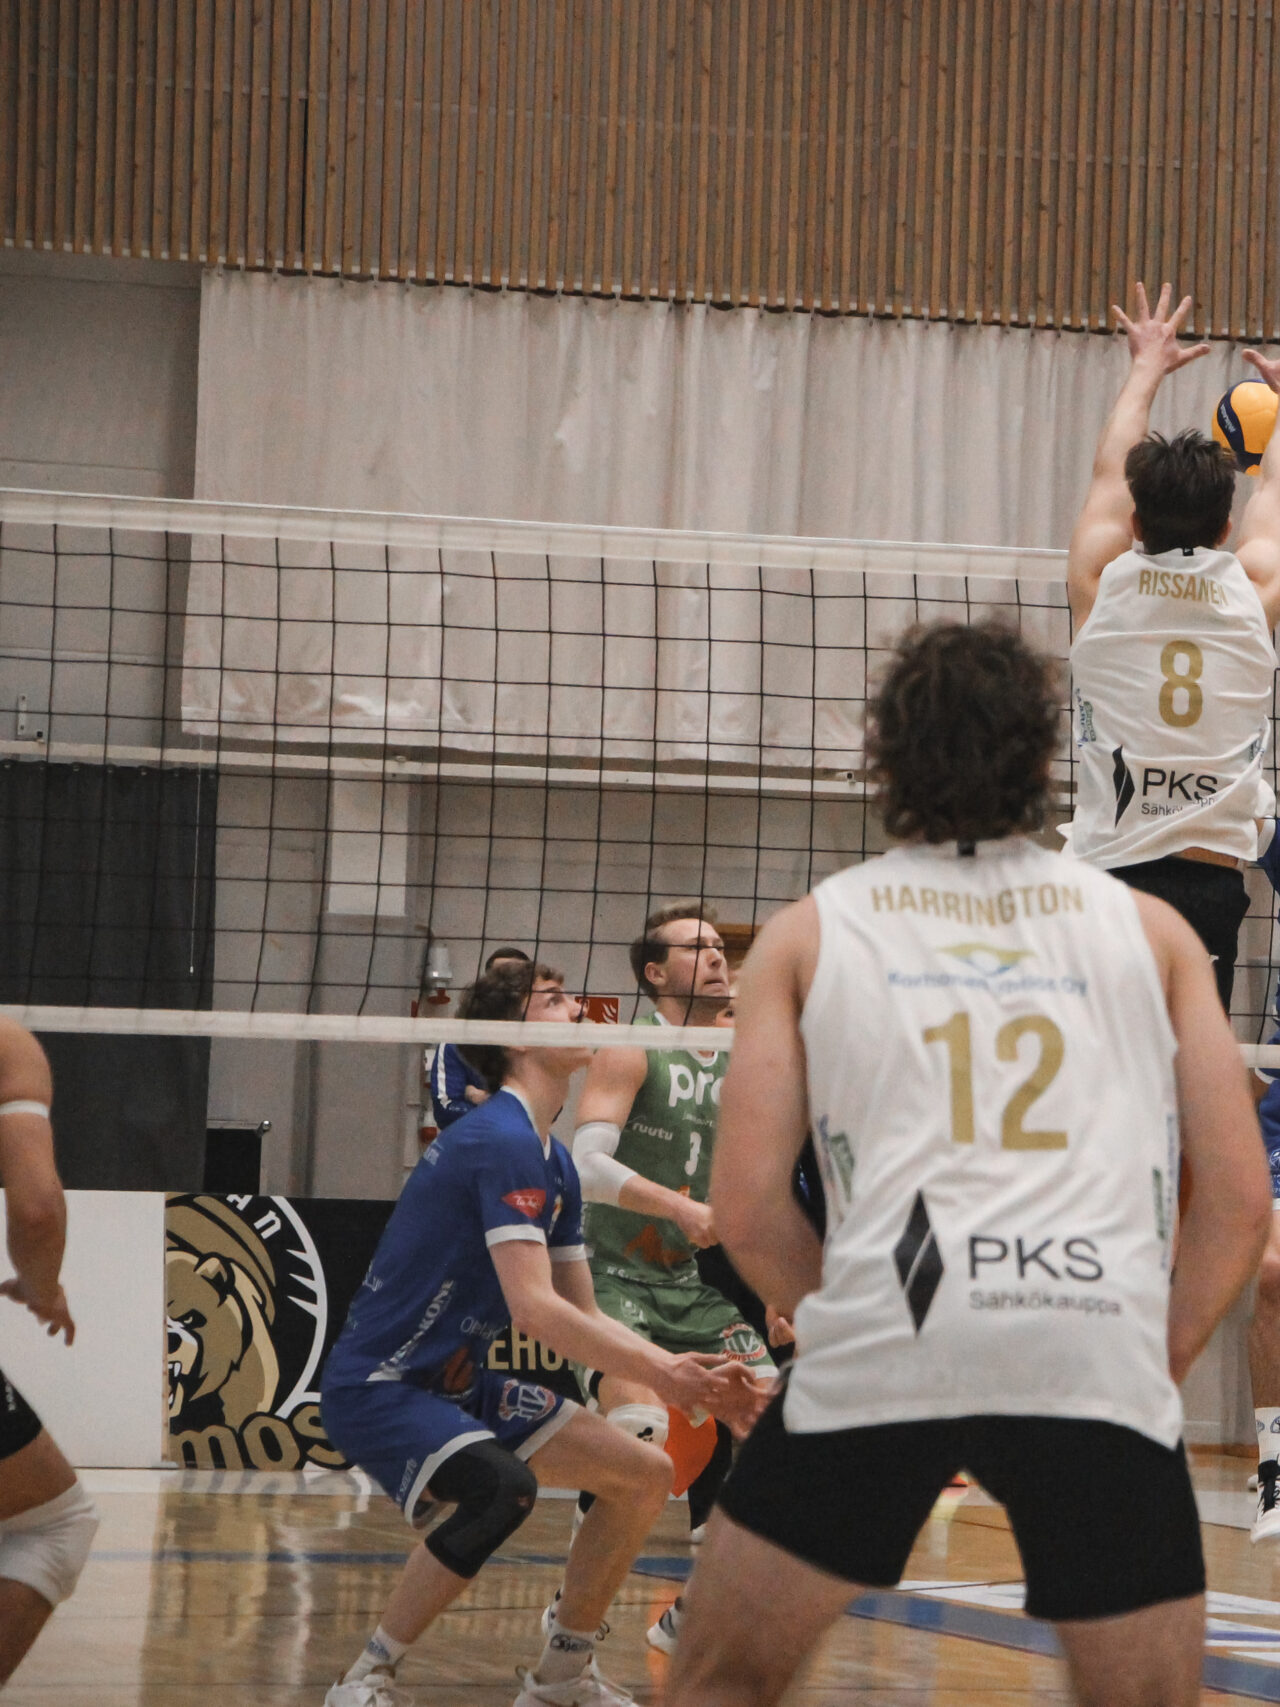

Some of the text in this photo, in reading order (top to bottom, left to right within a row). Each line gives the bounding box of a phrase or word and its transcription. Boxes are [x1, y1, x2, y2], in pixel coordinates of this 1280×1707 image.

[1158, 640, 1204, 728] 8
[1142, 767, 1218, 801] PKS
[871, 882, 1086, 928] HARRINGTON
[923, 1010, 1069, 1152] 12
[632, 1120, 673, 1142] ruutu
[967, 1236, 1104, 1283] PKS
[969, 1289, 1124, 1317] Sähkökauppa
